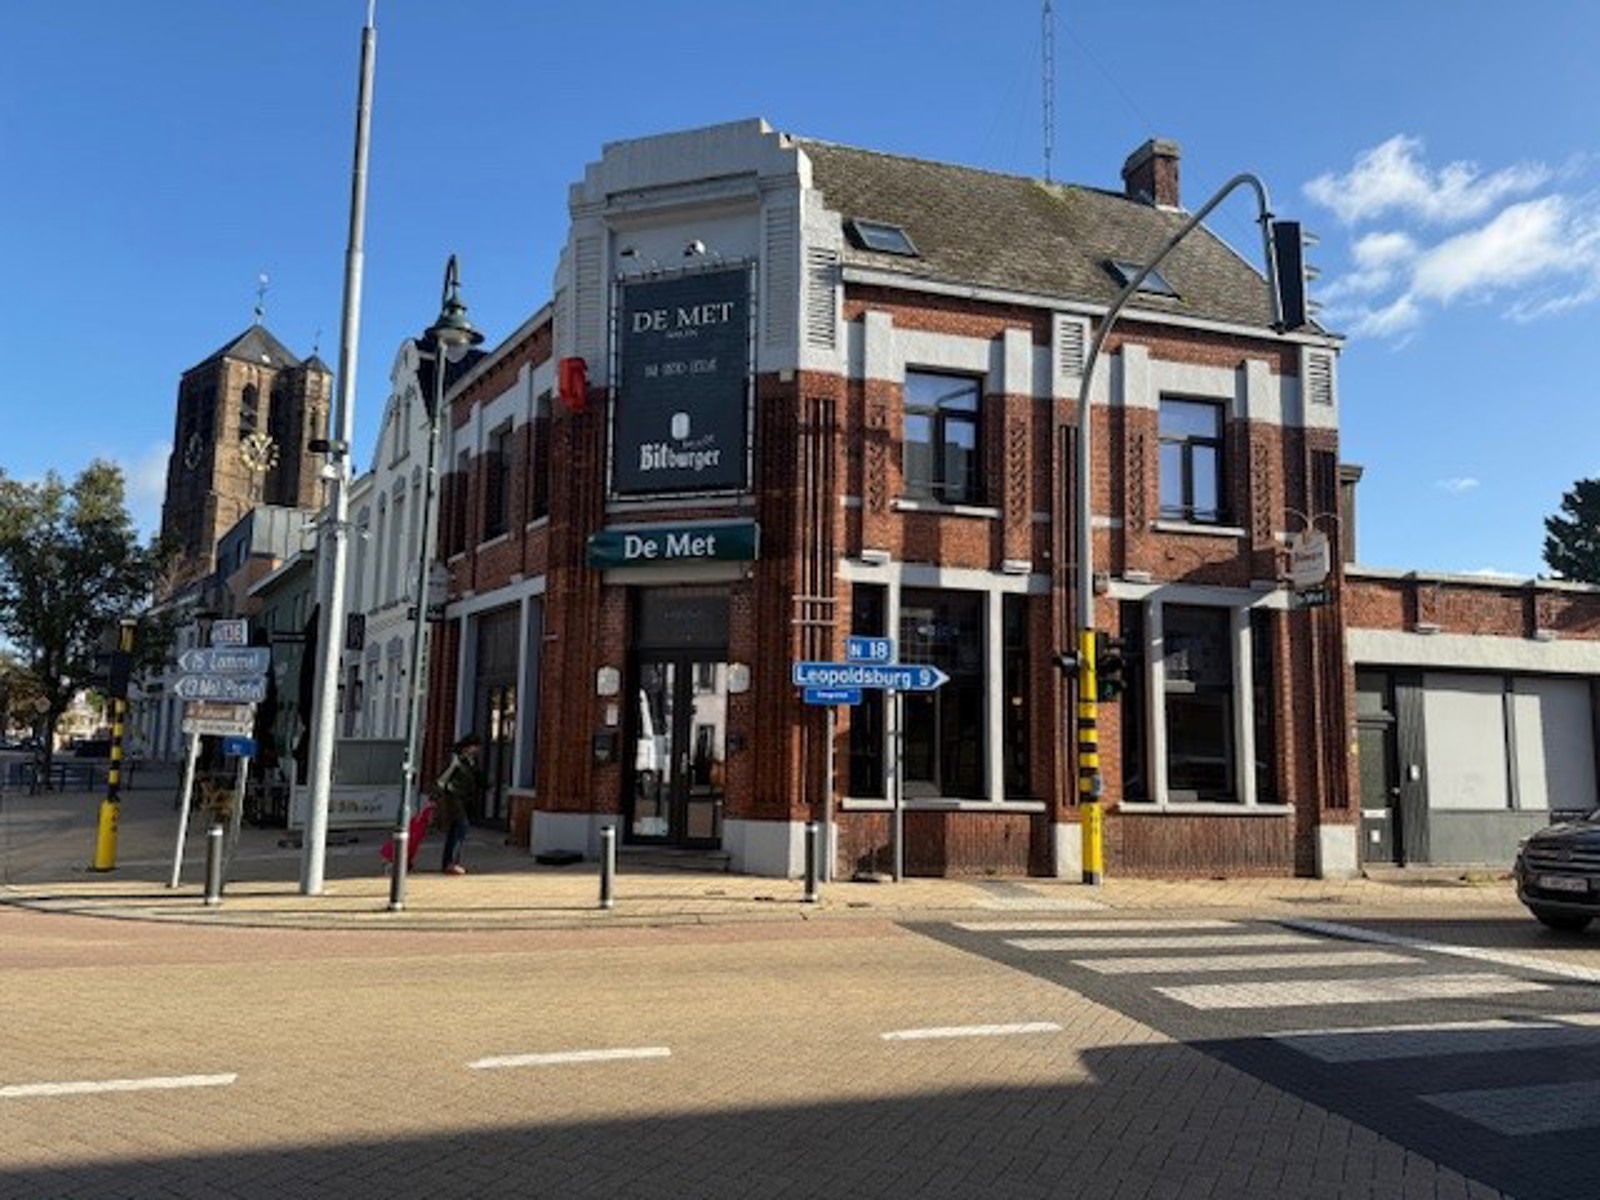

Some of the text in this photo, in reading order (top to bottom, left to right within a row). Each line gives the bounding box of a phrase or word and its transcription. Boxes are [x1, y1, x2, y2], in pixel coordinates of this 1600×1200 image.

[632, 302, 734, 333] DE MET
[624, 533, 716, 559] De Met
[850, 642, 889, 659] N 18
[797, 667, 931, 687] Leopoldsburg 9
